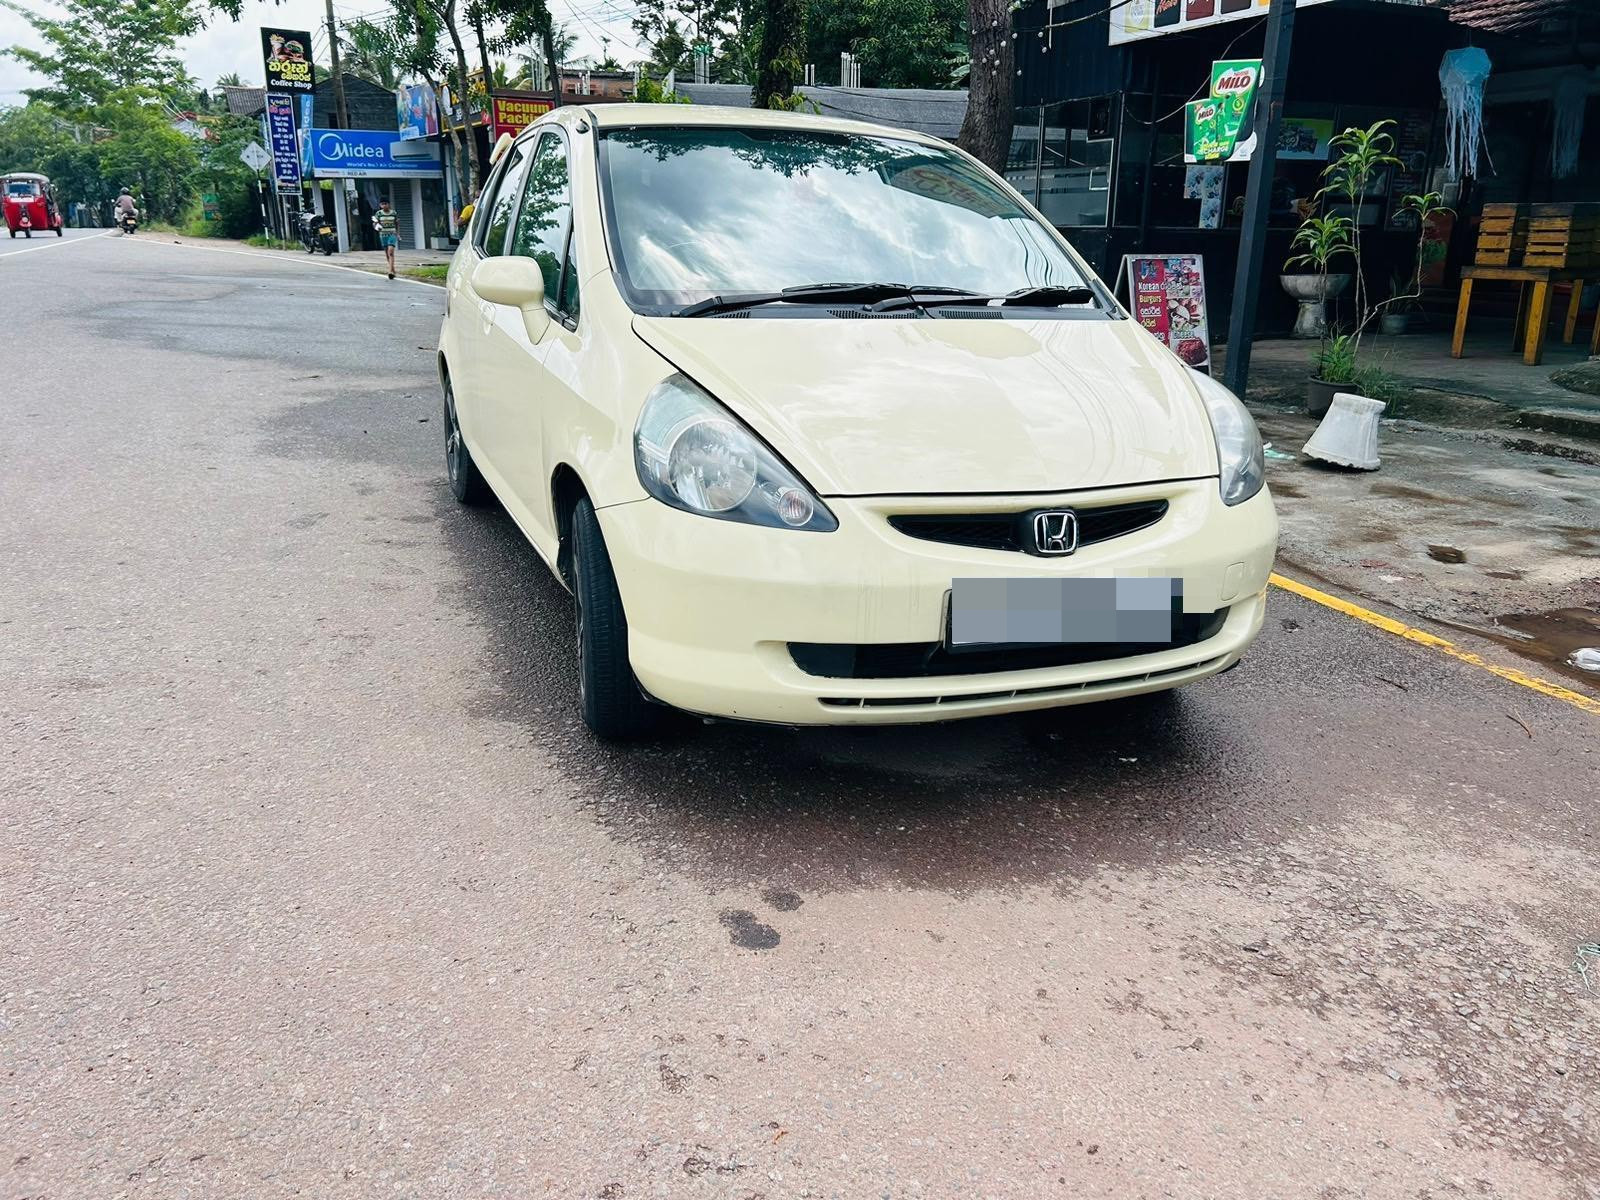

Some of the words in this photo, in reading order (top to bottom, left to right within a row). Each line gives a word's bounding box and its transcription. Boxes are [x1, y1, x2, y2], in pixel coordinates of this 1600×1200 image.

[270, 79, 293, 87] Coffee
[294, 81, 312, 90] Shop
[1218, 75, 1251, 90] MILO
[497, 100, 549, 113] Vacuum
[320, 136, 384, 160] Midea
[1138, 282, 1159, 291] Korean
